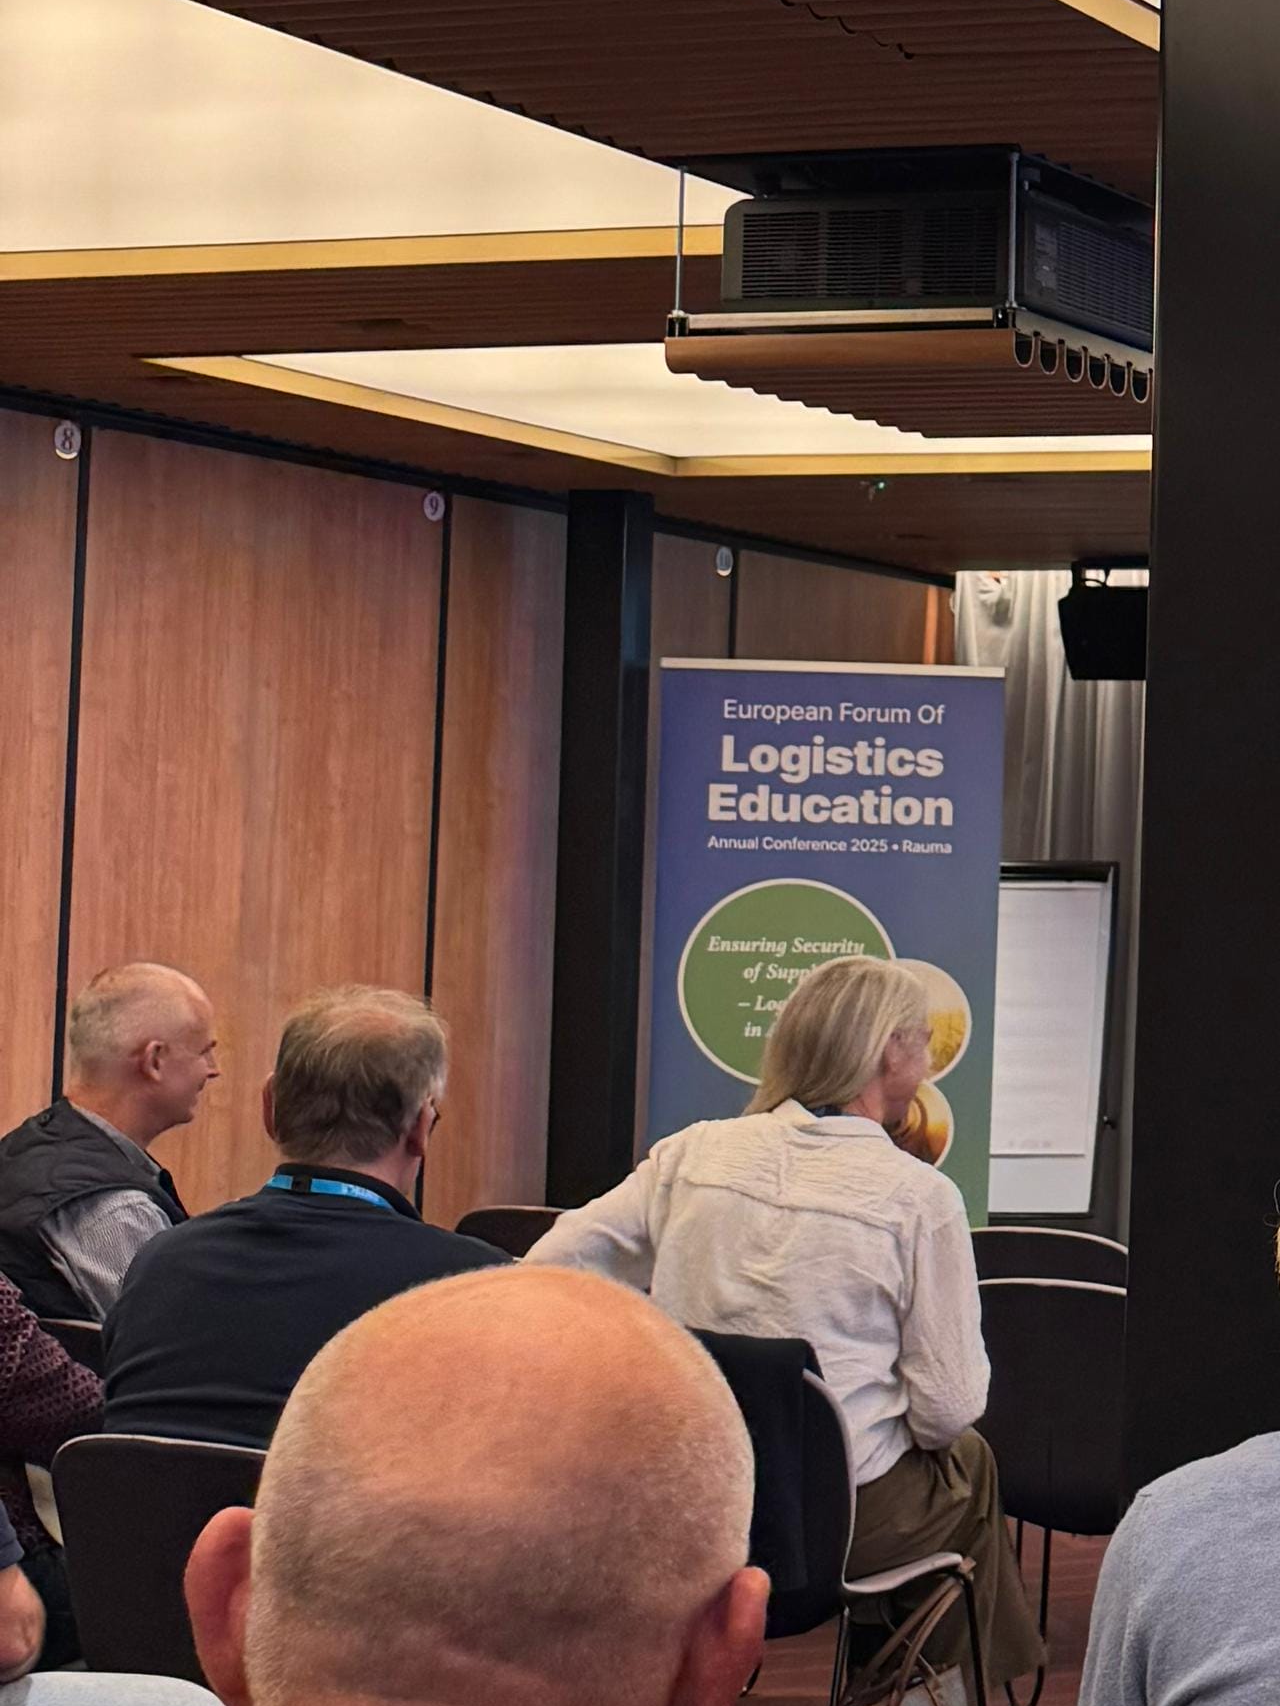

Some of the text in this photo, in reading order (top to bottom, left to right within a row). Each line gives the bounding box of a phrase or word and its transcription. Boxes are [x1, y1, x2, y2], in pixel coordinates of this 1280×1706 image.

[722, 698, 946, 725] European Forum Of
[720, 734, 945, 784] Logistics
[707, 783, 954, 827] Education
[707, 835, 953, 855] Annual Conference 2025 Rauma
[707, 936, 865, 957] Ensuring Security
[743, 961, 817, 983] of Supp
[744, 1021, 762, 1037] in
